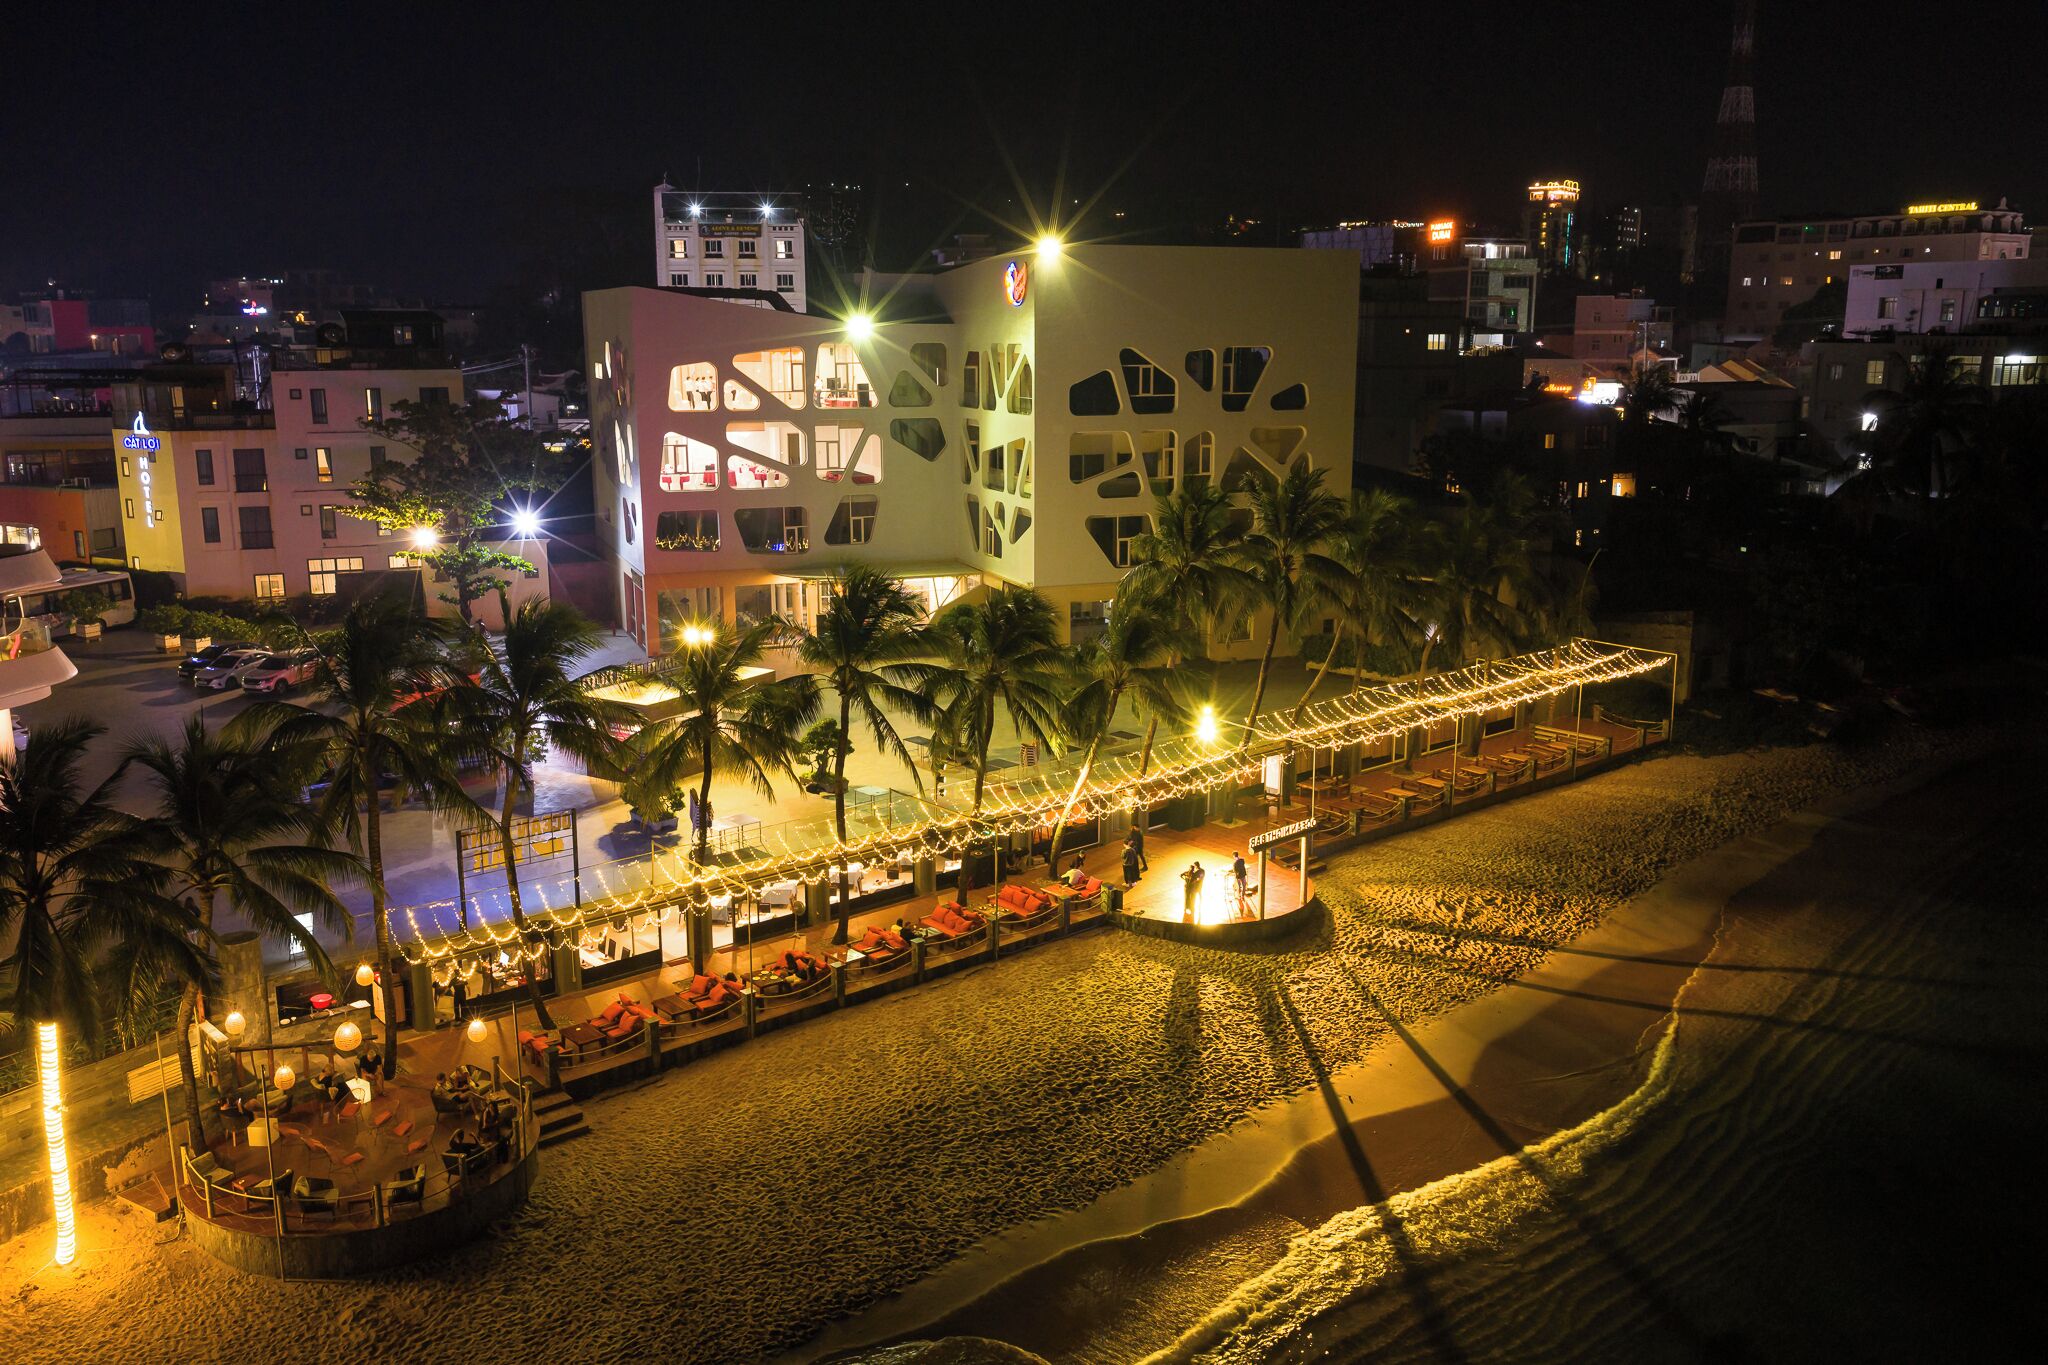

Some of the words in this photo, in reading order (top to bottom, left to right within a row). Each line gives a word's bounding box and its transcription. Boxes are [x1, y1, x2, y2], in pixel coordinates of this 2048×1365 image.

[1908, 205, 1937, 214] TAHITI
[1937, 202, 1978, 211] CENTRAL
[123, 434, 140, 449] CÁT
[139, 456, 155, 528] HOTEL
